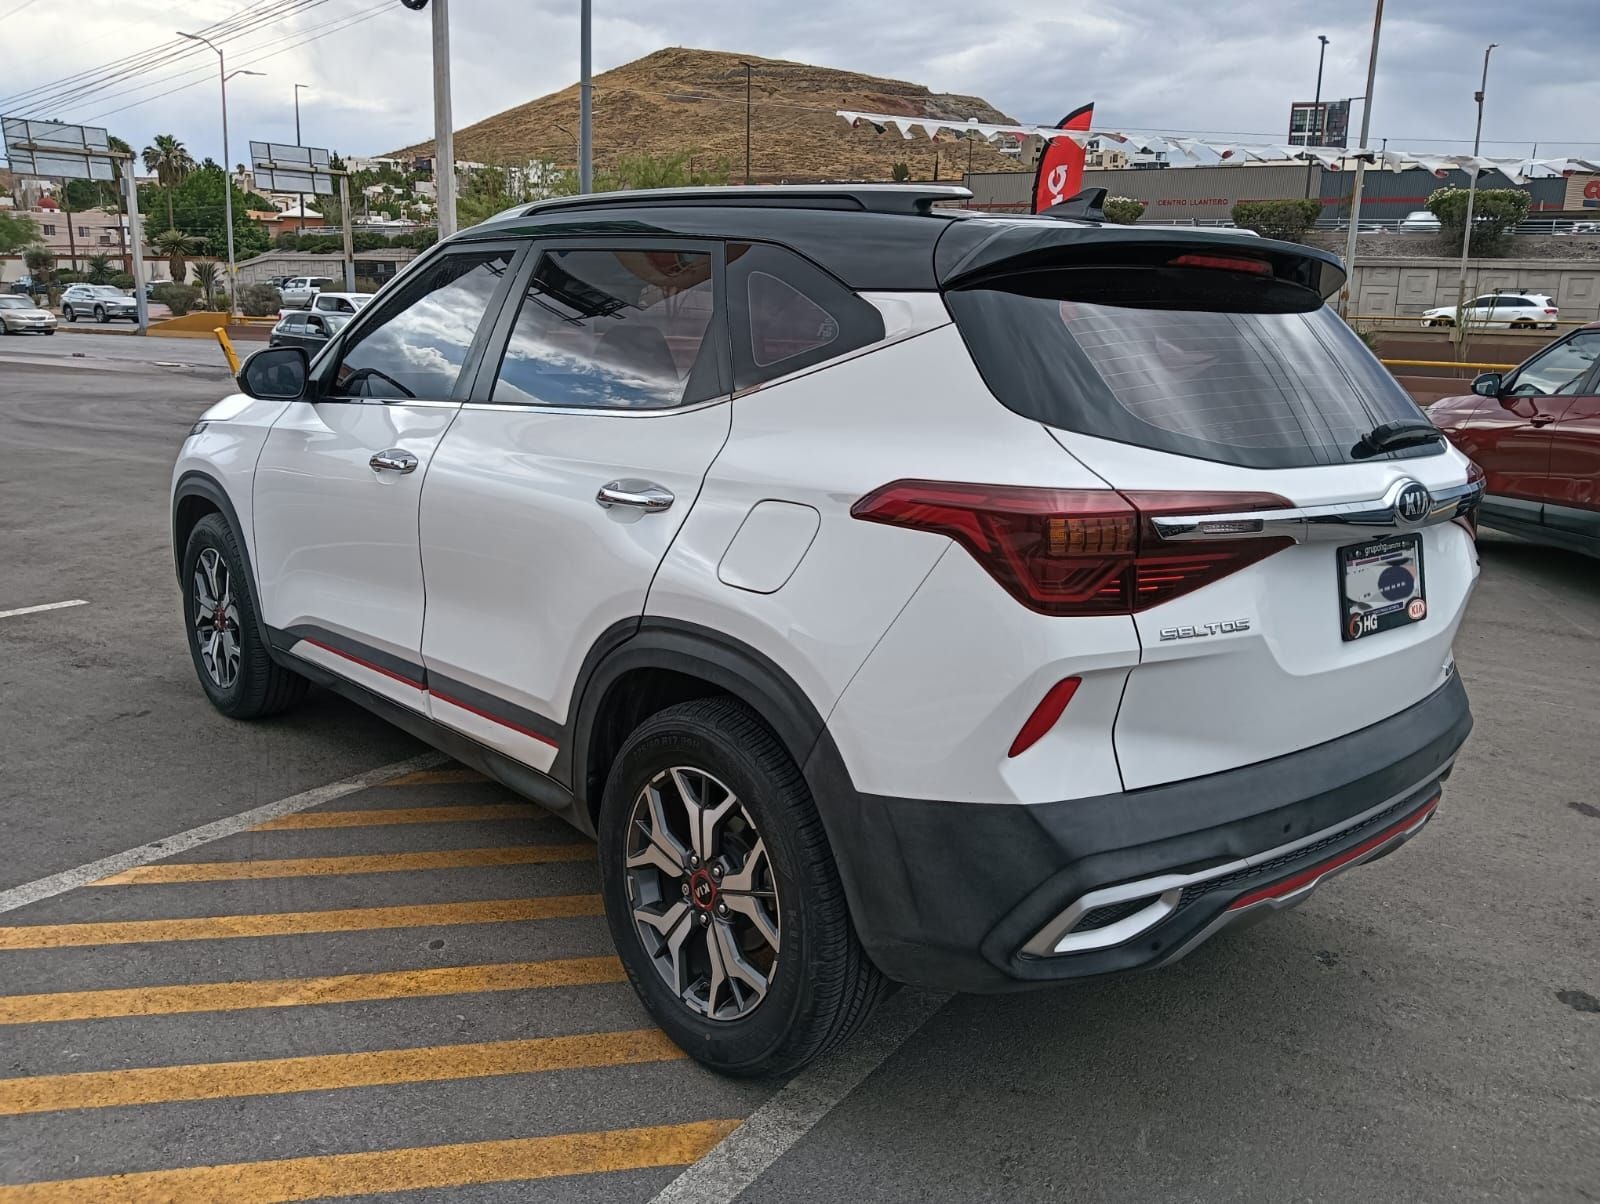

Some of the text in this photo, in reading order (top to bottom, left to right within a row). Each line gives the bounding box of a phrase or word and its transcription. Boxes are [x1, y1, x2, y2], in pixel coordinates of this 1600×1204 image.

[1189, 198, 1229, 206] LLANTERO
[1404, 491, 1429, 516] KIA
[1159, 618, 1250, 641] SELTOS
